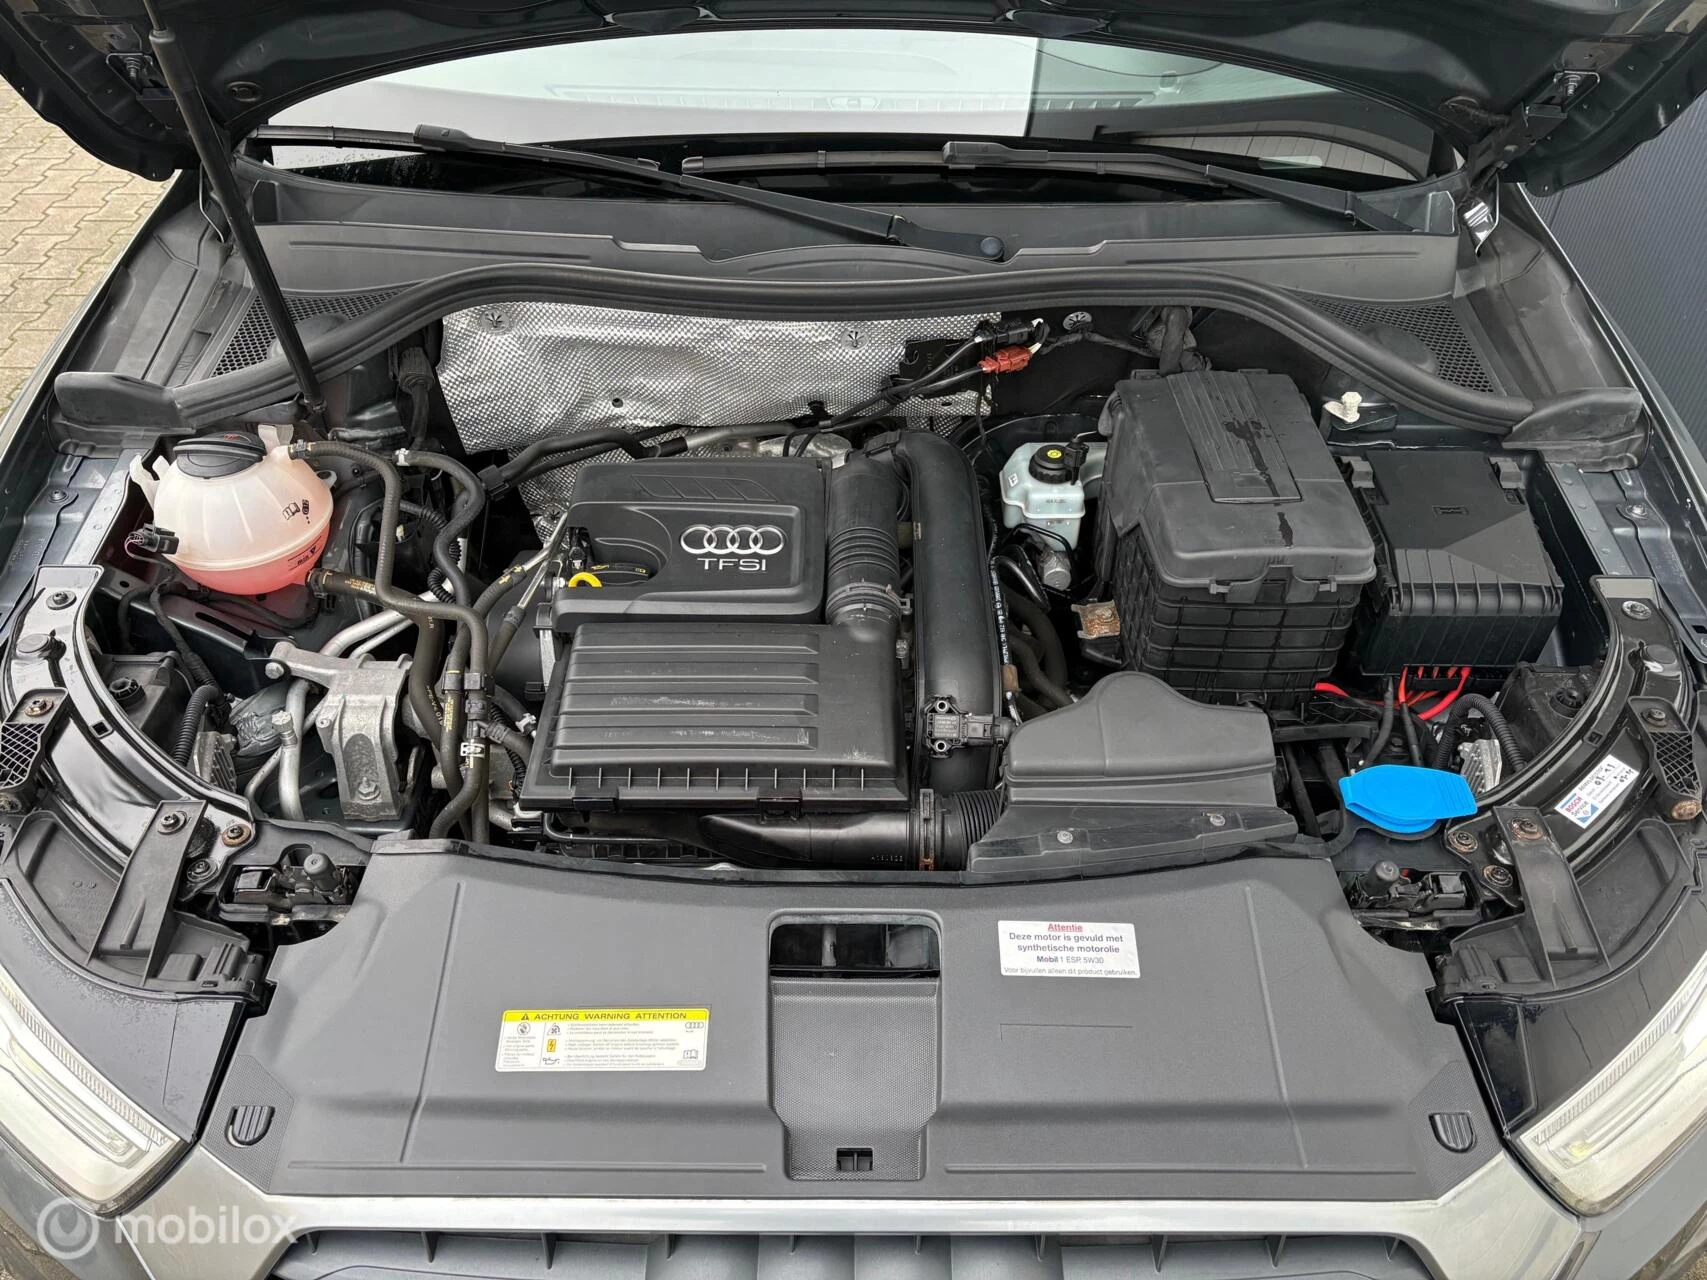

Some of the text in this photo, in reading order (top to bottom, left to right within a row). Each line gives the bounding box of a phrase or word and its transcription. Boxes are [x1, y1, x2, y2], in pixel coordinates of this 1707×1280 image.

[697, 558, 767, 572] TFSI
[1565, 796, 1583, 813] BOSCH
[1571, 800, 1589, 817] Service
[1047, 923, 1083, 933] Attentie
[1009, 932, 1124, 944] Deze motor is gevuld met
[1017, 944, 1120, 954] synthetische motorolie
[1036, 955, 1059, 963] Mobil
[1083, 956, 1105, 964] 5W30
[1077, 968, 1103, 976] product
[534, 1011, 688, 1021] ACHTUNG WARNING ATTENTION
